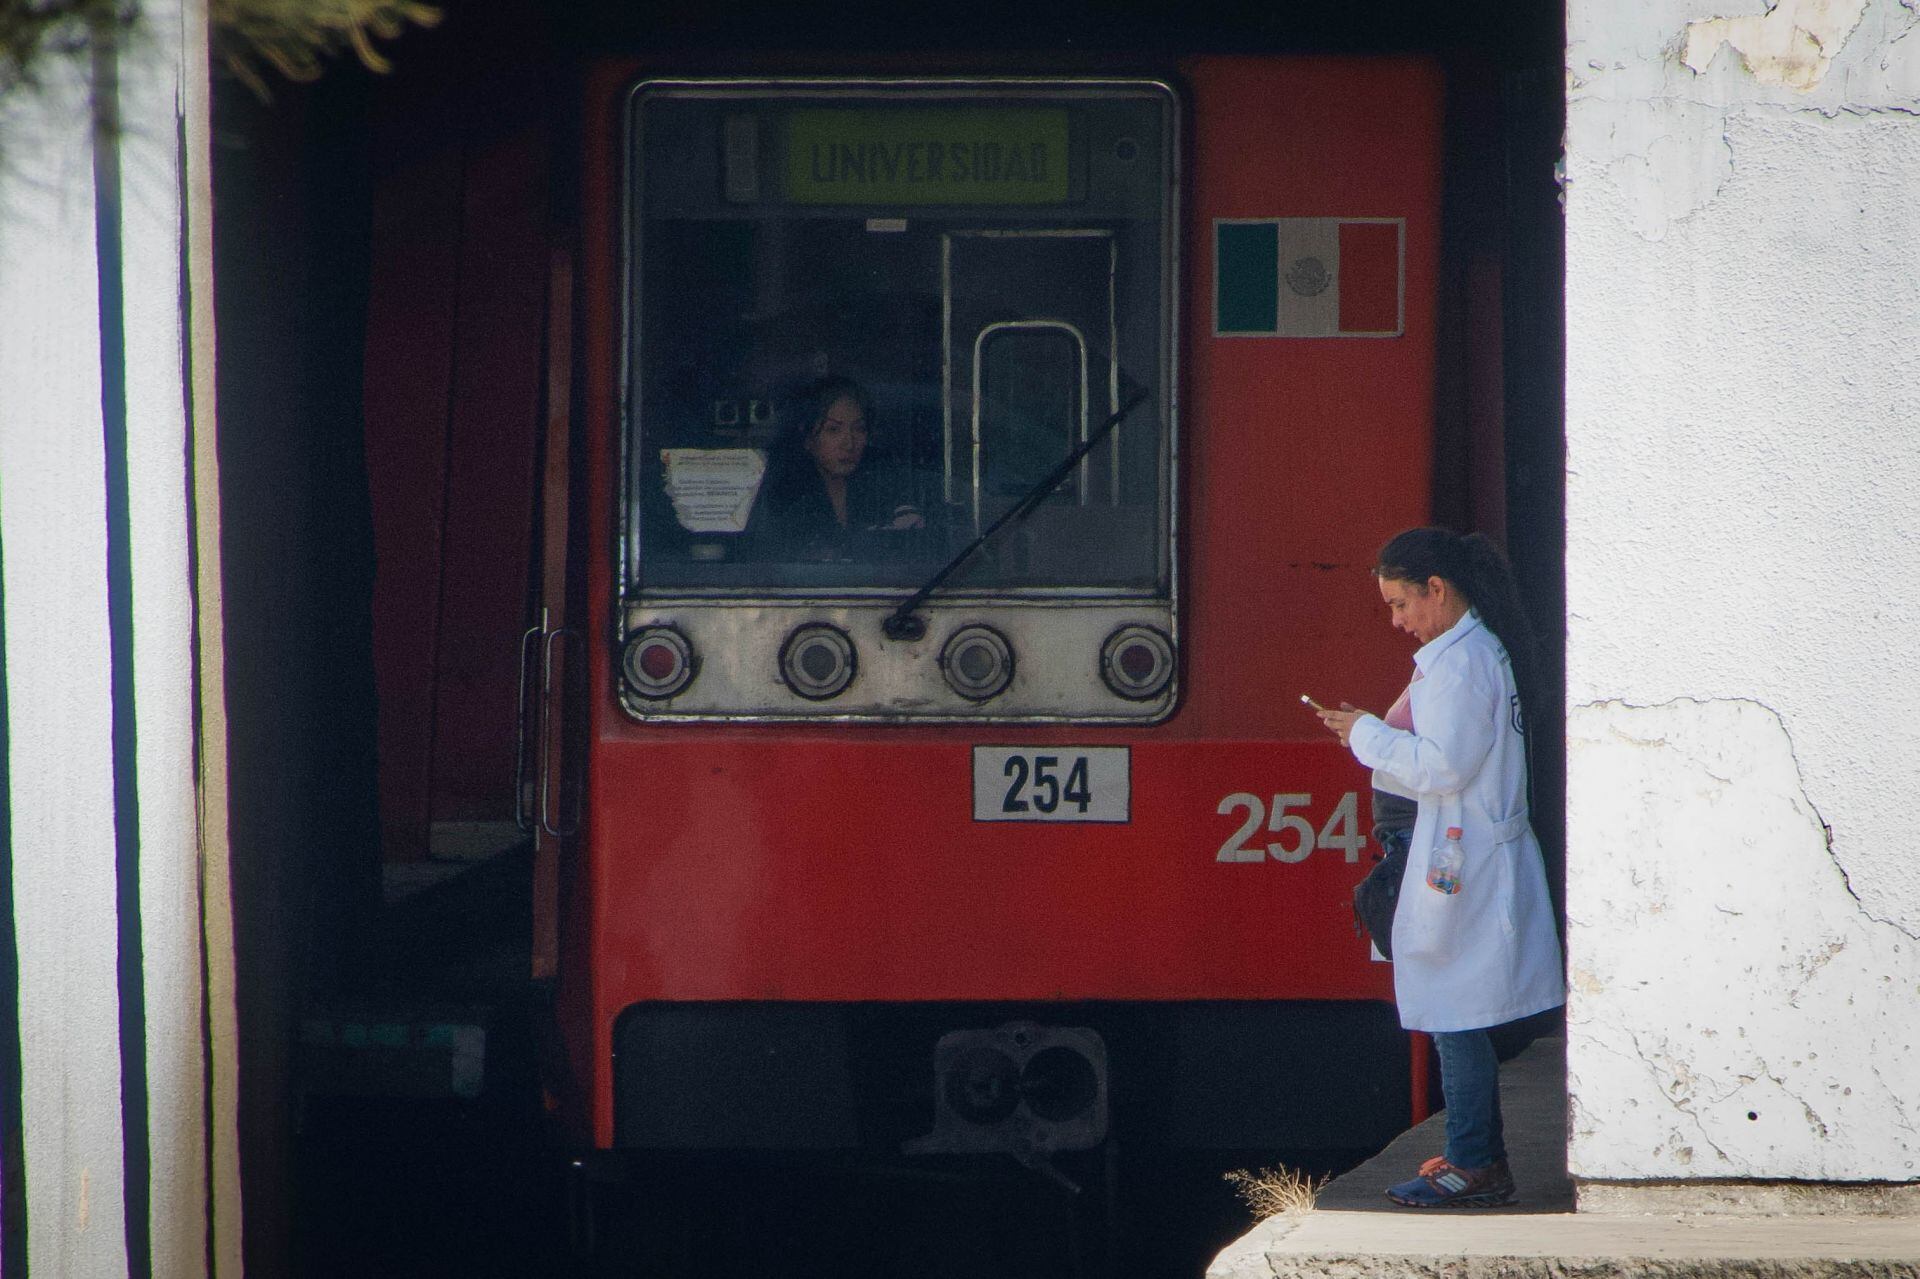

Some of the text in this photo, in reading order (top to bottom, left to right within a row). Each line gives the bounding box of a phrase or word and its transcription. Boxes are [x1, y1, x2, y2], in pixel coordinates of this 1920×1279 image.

[812, 142, 1049, 183] UNIVERSIDAD
[1002, 755, 1091, 813] 254
[1216, 792, 1366, 864] 254
